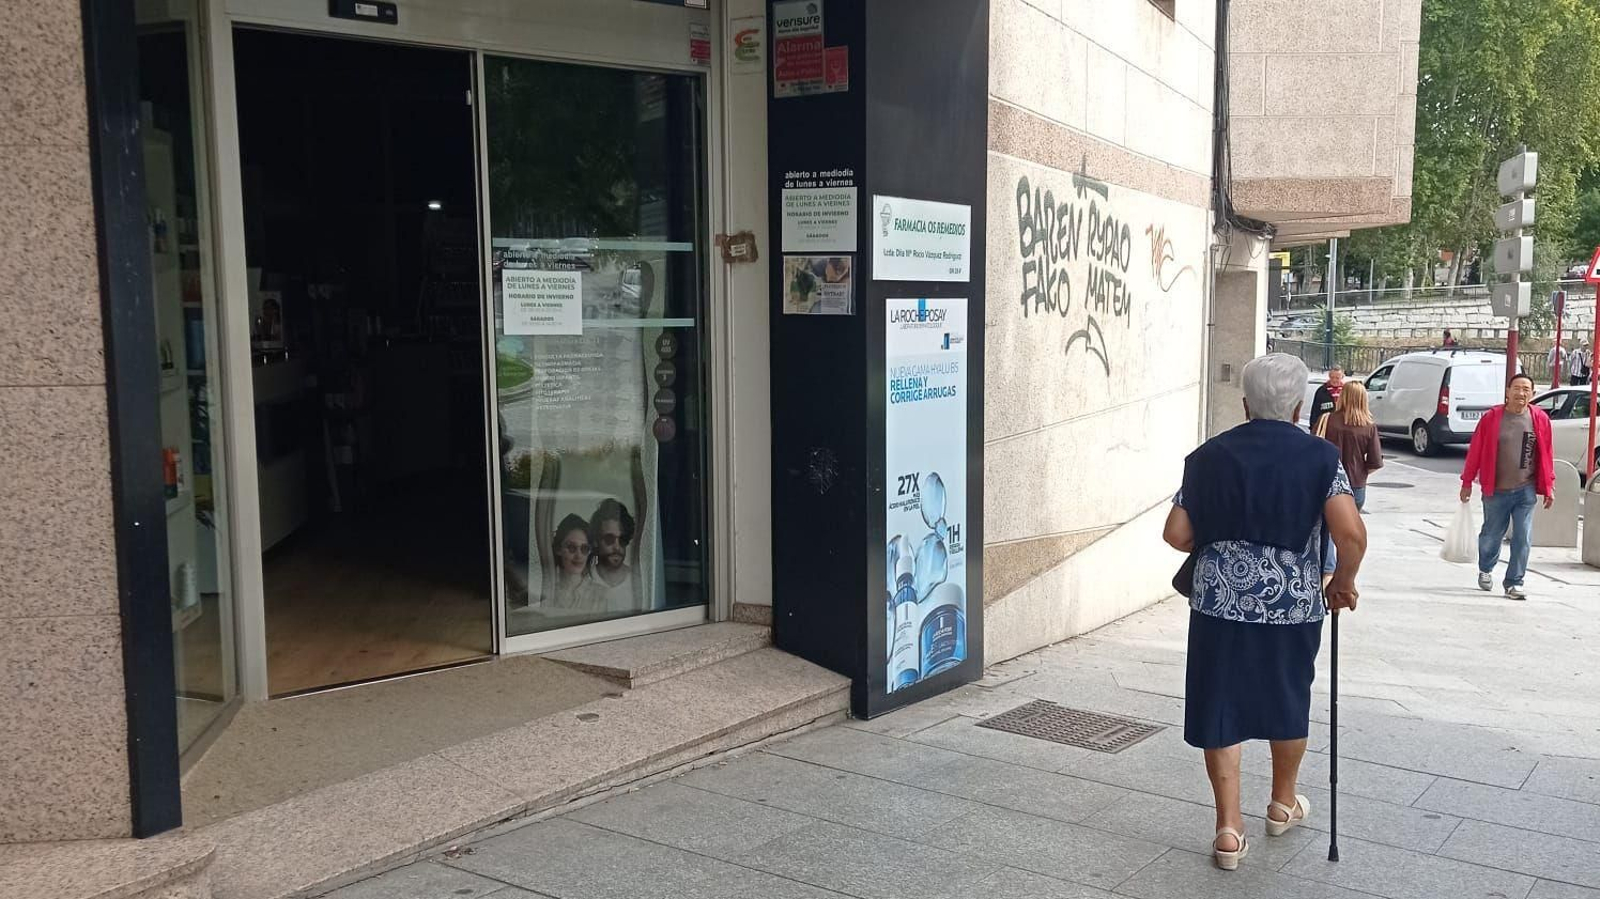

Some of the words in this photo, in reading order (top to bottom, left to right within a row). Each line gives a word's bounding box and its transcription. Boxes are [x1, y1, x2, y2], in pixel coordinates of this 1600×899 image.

[776, 15, 821, 28] verisure
[785, 171, 810, 179] abierto
[785, 180, 795, 188] de
[796, 179, 817, 187] lunes
[826, 178, 854, 187] viernes
[894, 218, 926, 232] FARMACIA
[927, 221, 937, 233] OS
[937, 221, 966, 236] REMEDIOS
[547, 283, 575, 291] VIERNES
[890, 309, 900, 323] LA
[890, 377, 922, 392] RELLENA
[923, 376, 929, 387] Y
[890, 389, 922, 404] CORRIGE
[923, 385, 957, 400] ARRUGAS
[897, 472, 920, 496] 27X
